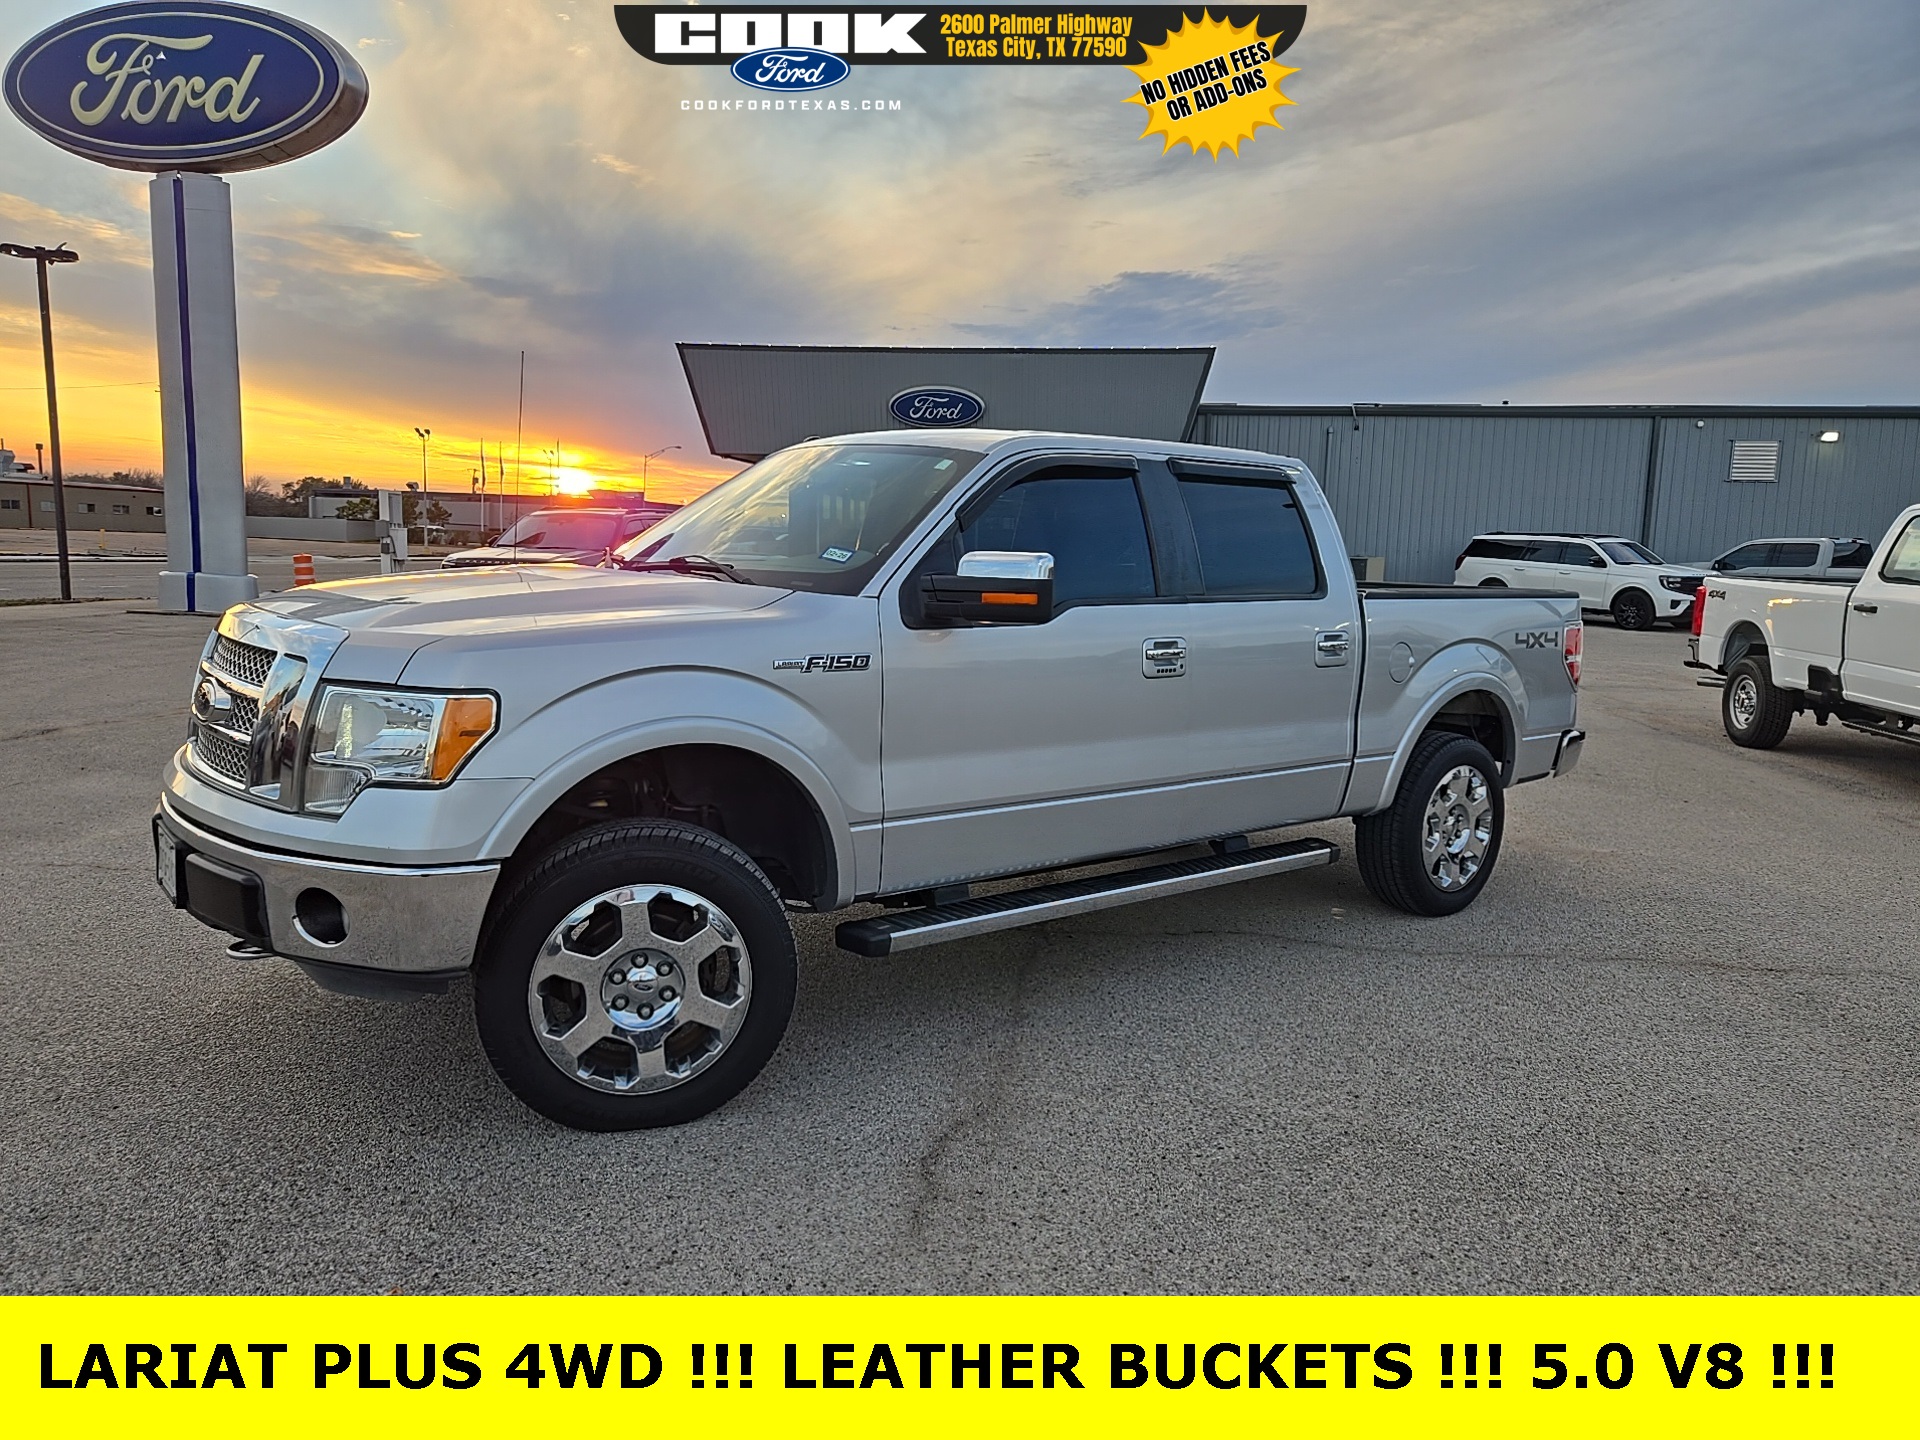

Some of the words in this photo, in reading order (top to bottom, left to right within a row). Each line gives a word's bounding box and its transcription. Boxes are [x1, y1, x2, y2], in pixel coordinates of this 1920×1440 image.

[70, 33, 265, 126] Ford
[909, 396, 963, 419] Ford
[1514, 631, 1559, 649] 4X4
[801, 653, 872, 673] F-150
